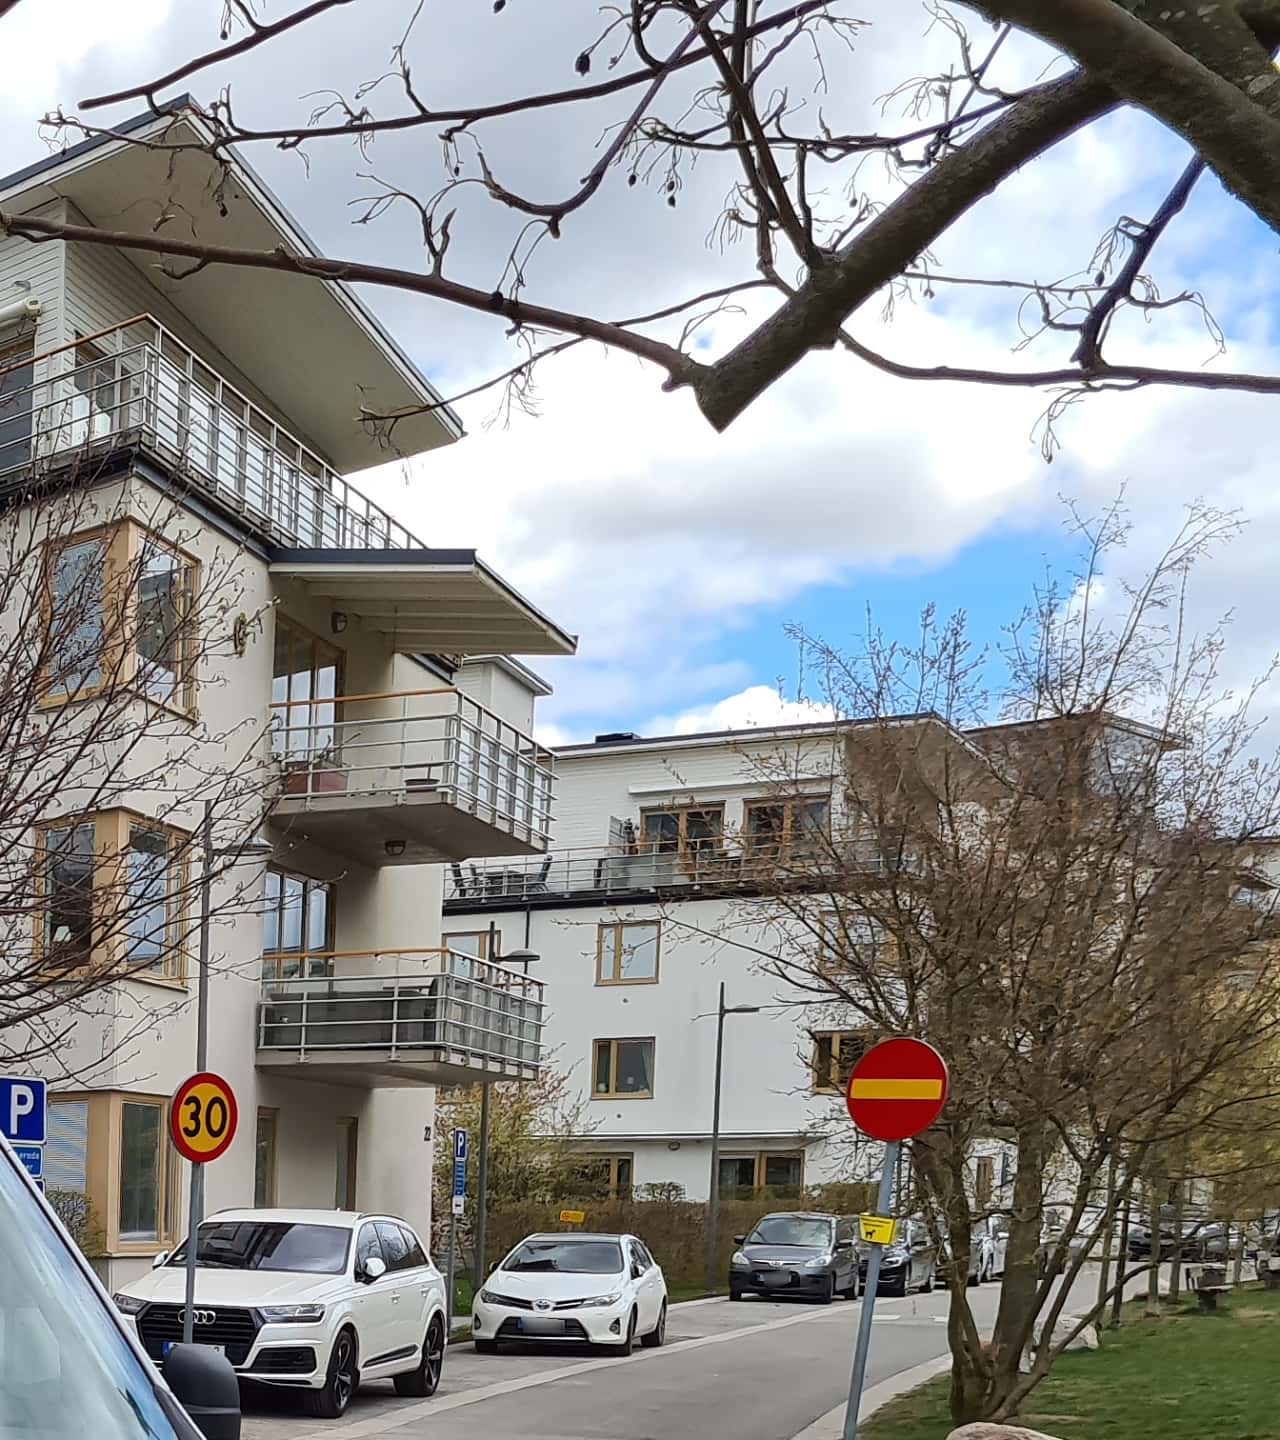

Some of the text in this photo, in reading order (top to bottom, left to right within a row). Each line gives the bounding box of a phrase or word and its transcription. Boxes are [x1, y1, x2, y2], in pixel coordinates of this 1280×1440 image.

[9, 1084, 34, 1135] P
[183, 1096, 227, 1137] 30
[457, 1133, 465, 1156] P
